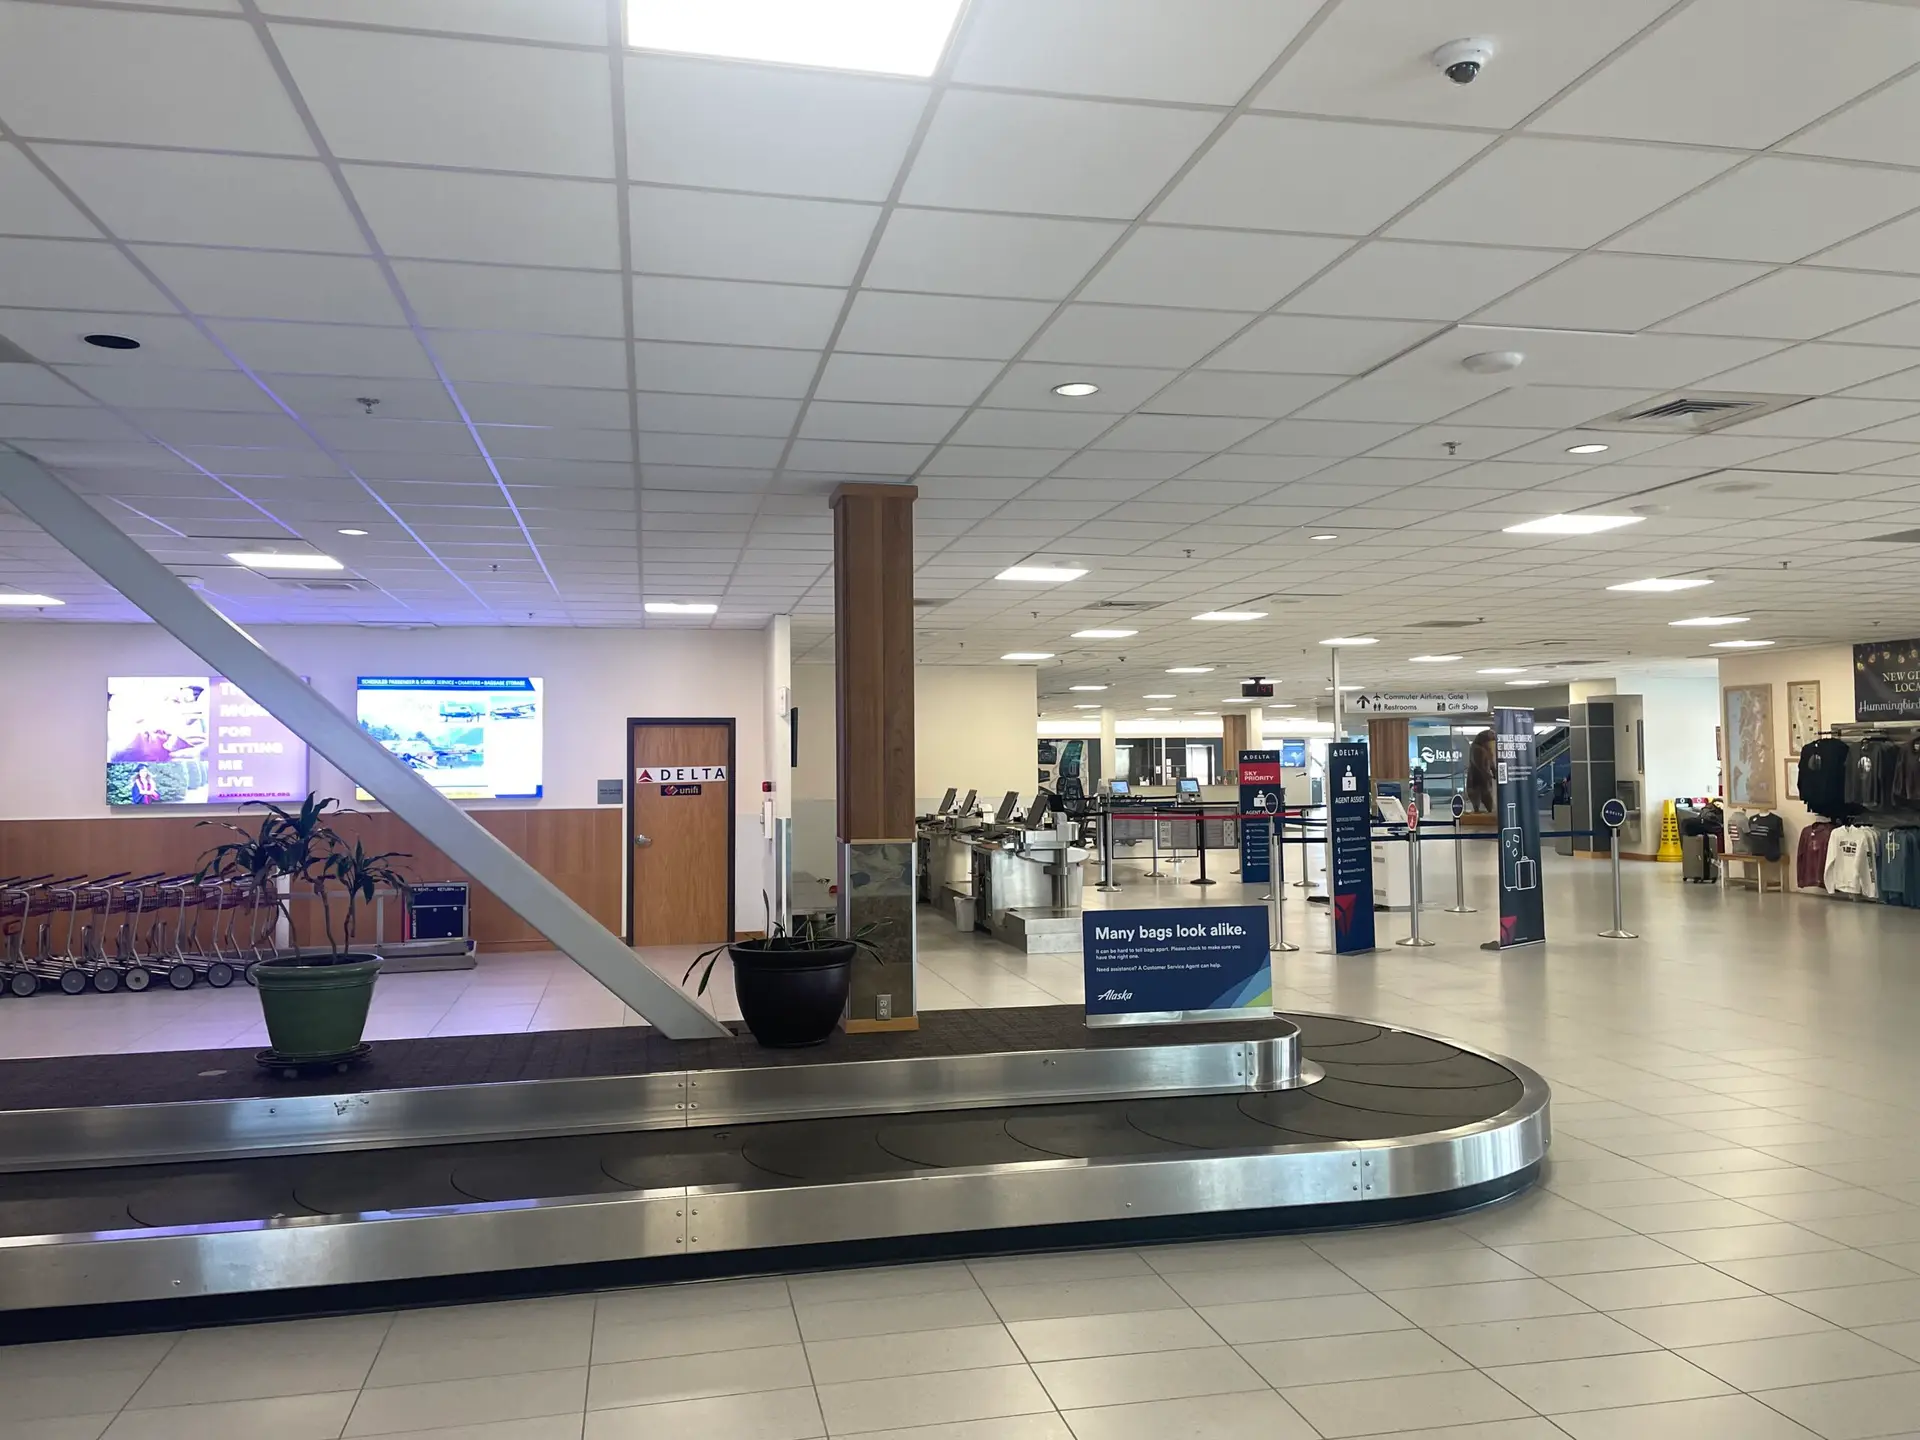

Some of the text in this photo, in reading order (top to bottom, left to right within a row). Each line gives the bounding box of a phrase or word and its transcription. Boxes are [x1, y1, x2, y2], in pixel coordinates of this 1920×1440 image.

[1882, 672, 1905, 681] NEW
[1461, 703, 1478, 711] Shop
[218, 726, 252, 737] FOR
[218, 742, 283, 754] LETTING
[218, 760, 243, 771] ME
[661, 768, 725, 780] DELTA
[217, 776, 253, 788] LIVE
[1095, 922, 1247, 942] Many bags look alike.
[1098, 989, 1133, 1001] Alaska
